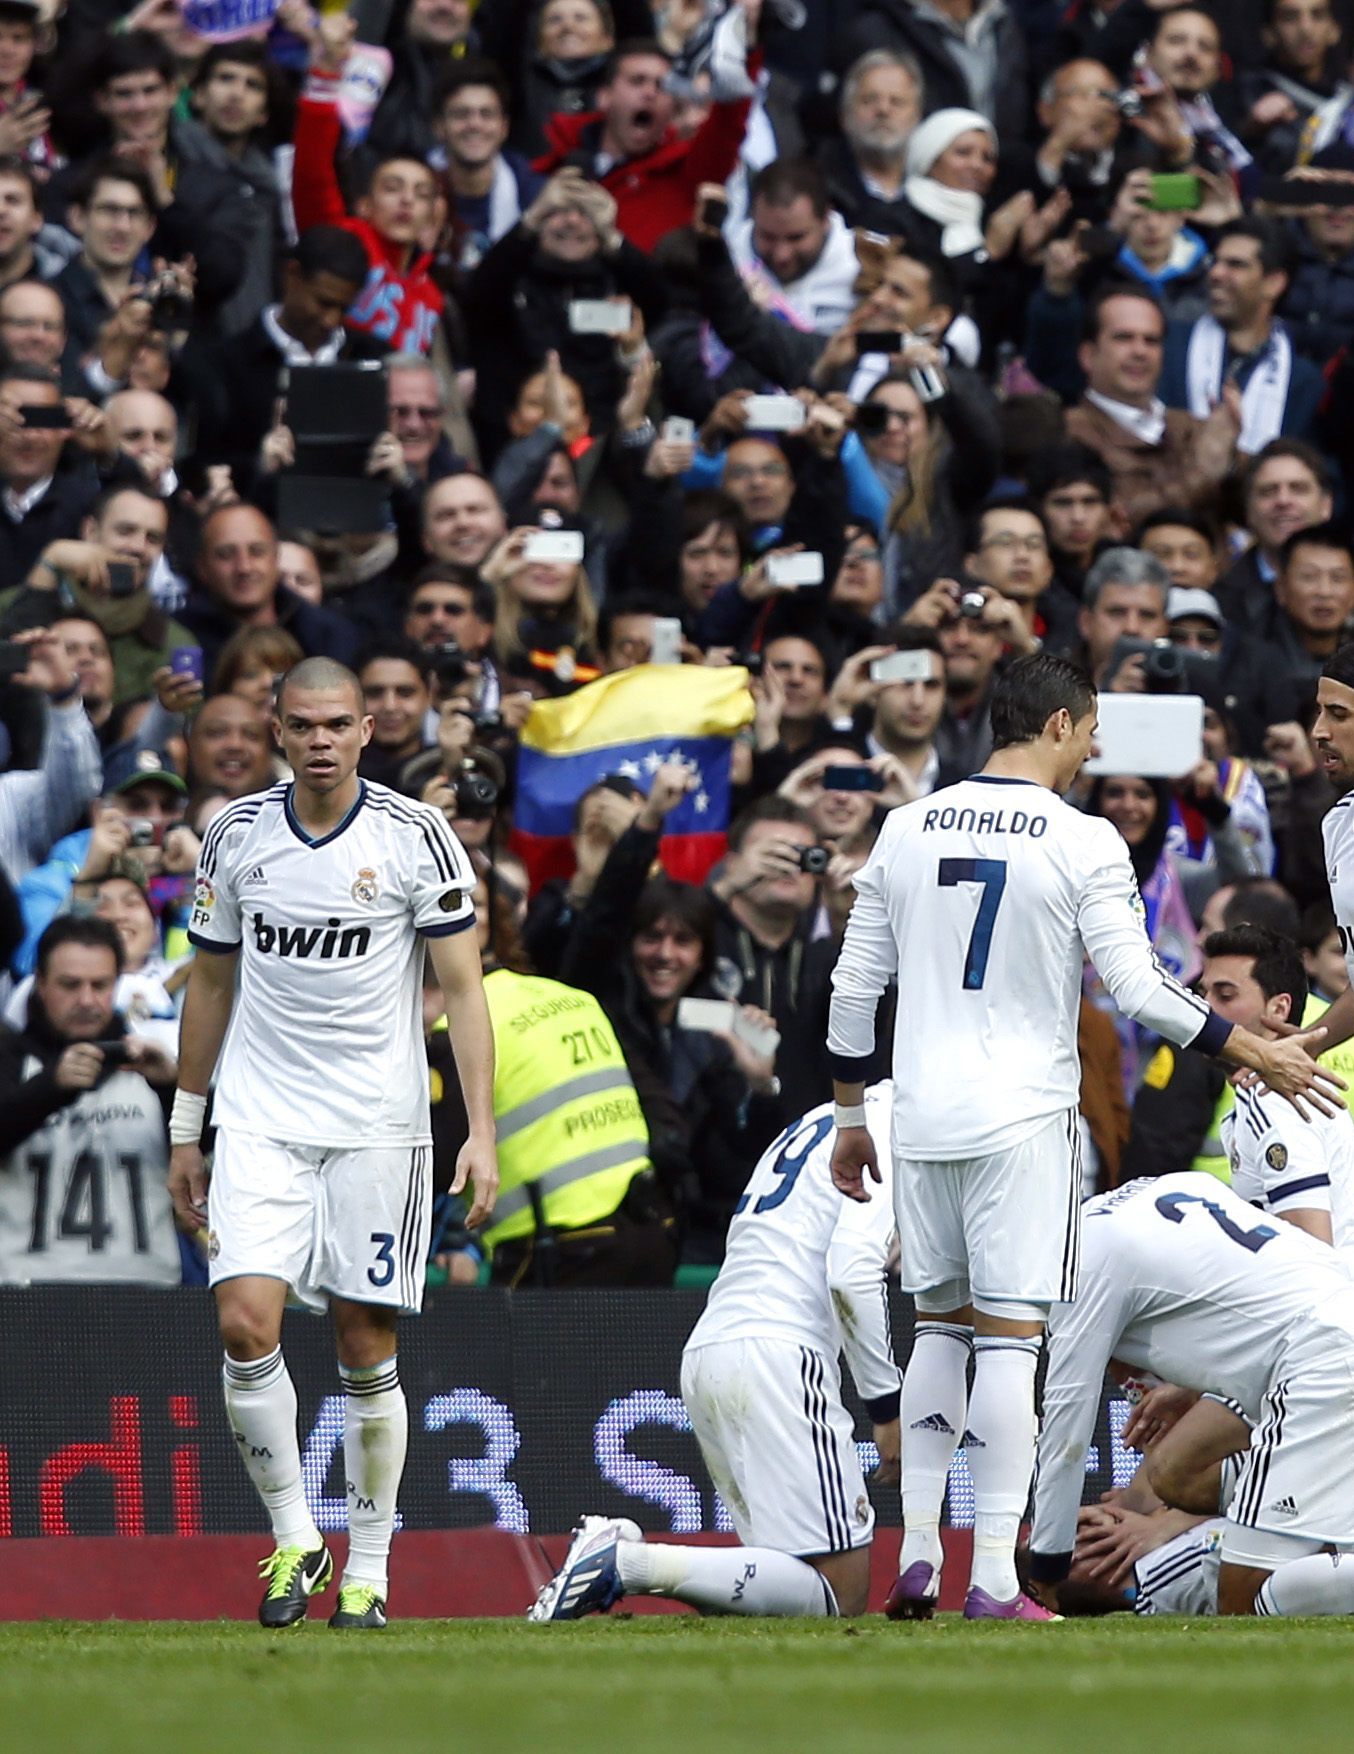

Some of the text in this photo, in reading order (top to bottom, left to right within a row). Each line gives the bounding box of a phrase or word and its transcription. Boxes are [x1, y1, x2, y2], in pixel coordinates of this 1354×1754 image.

[922, 807, 1047, 838] RONALDO
[254, 912, 372, 959] bwin
[937, 857, 1008, 990] 7
[562, 1026, 612, 1066] 270
[27, 1148, 150, 1254] 141
[1155, 1191, 1281, 1254] 2
[367, 1232, 395, 1287] 3
[0, 1395, 200, 1537] di
